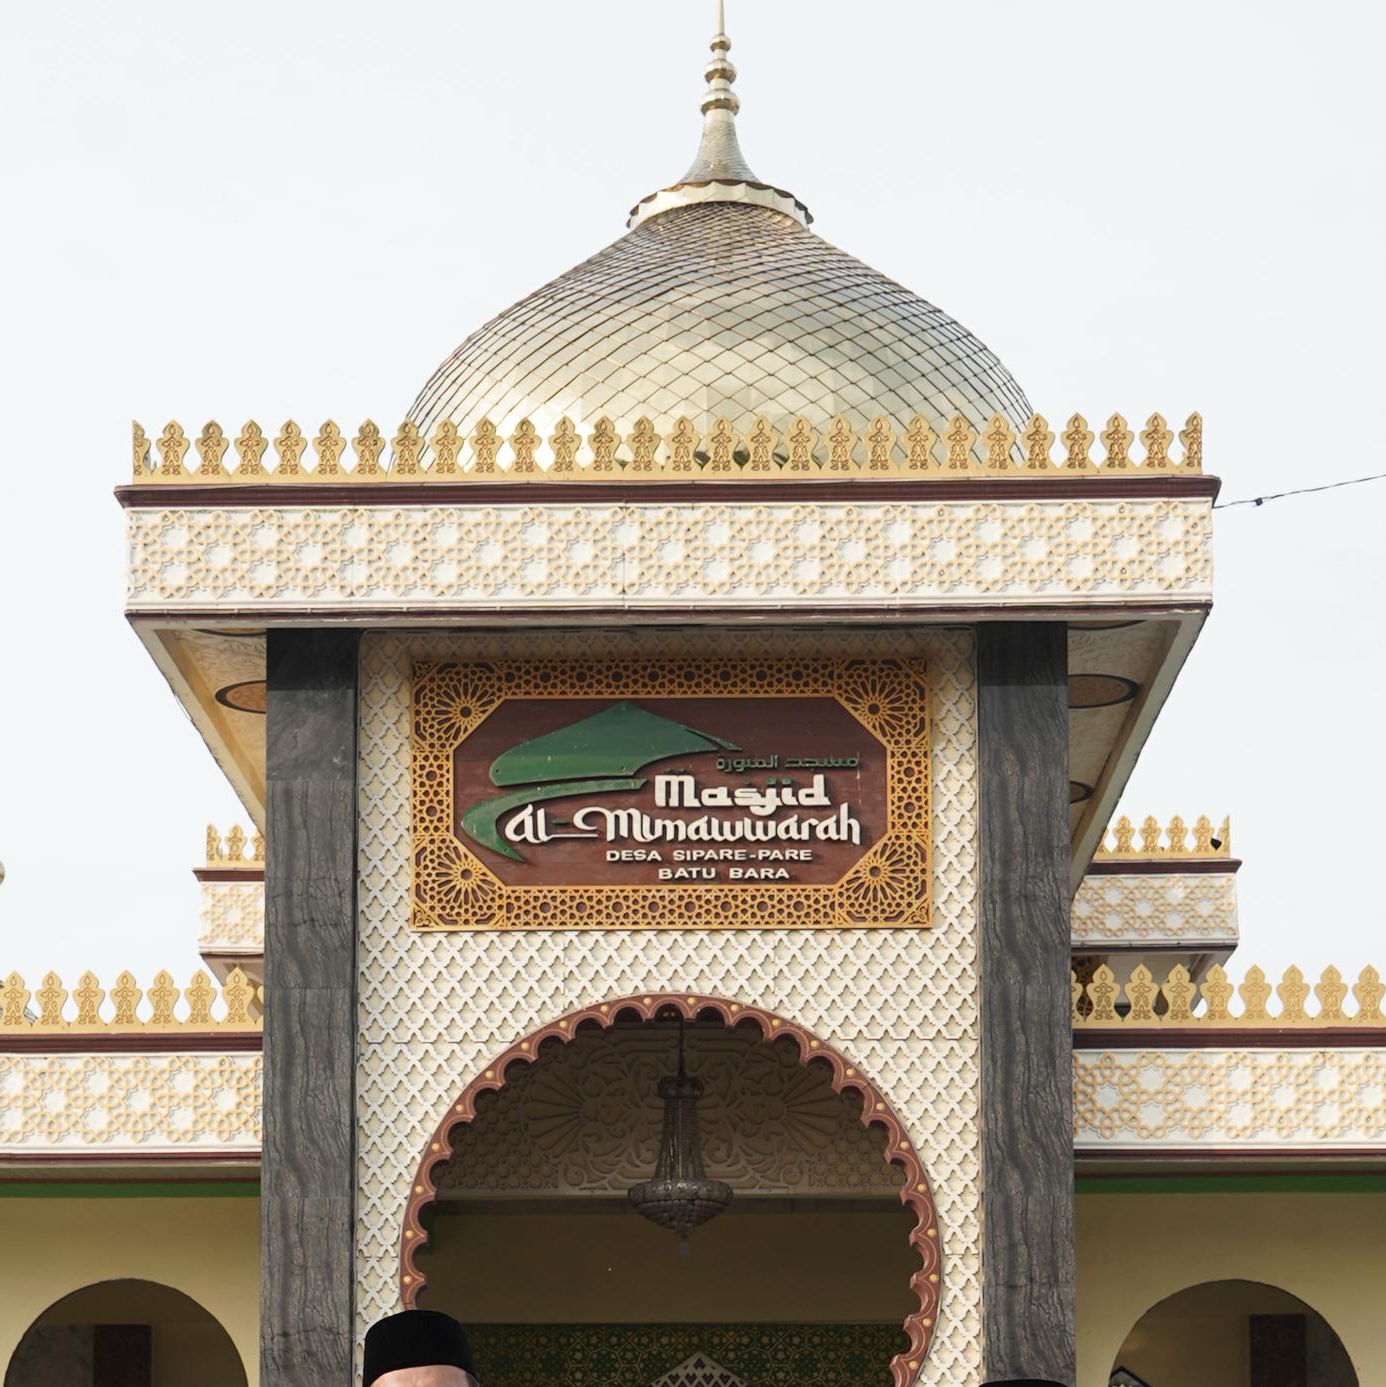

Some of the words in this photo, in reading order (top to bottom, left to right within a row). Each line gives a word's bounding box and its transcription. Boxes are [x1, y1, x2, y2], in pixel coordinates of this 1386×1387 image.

[653, 773, 831, 817] Masjid
[605, 848, 662, 862] DESA
[673, 848, 813, 862] SIPARE-PARE
[658, 867, 716, 880] BATU
[728, 867, 790, 880] BARA
